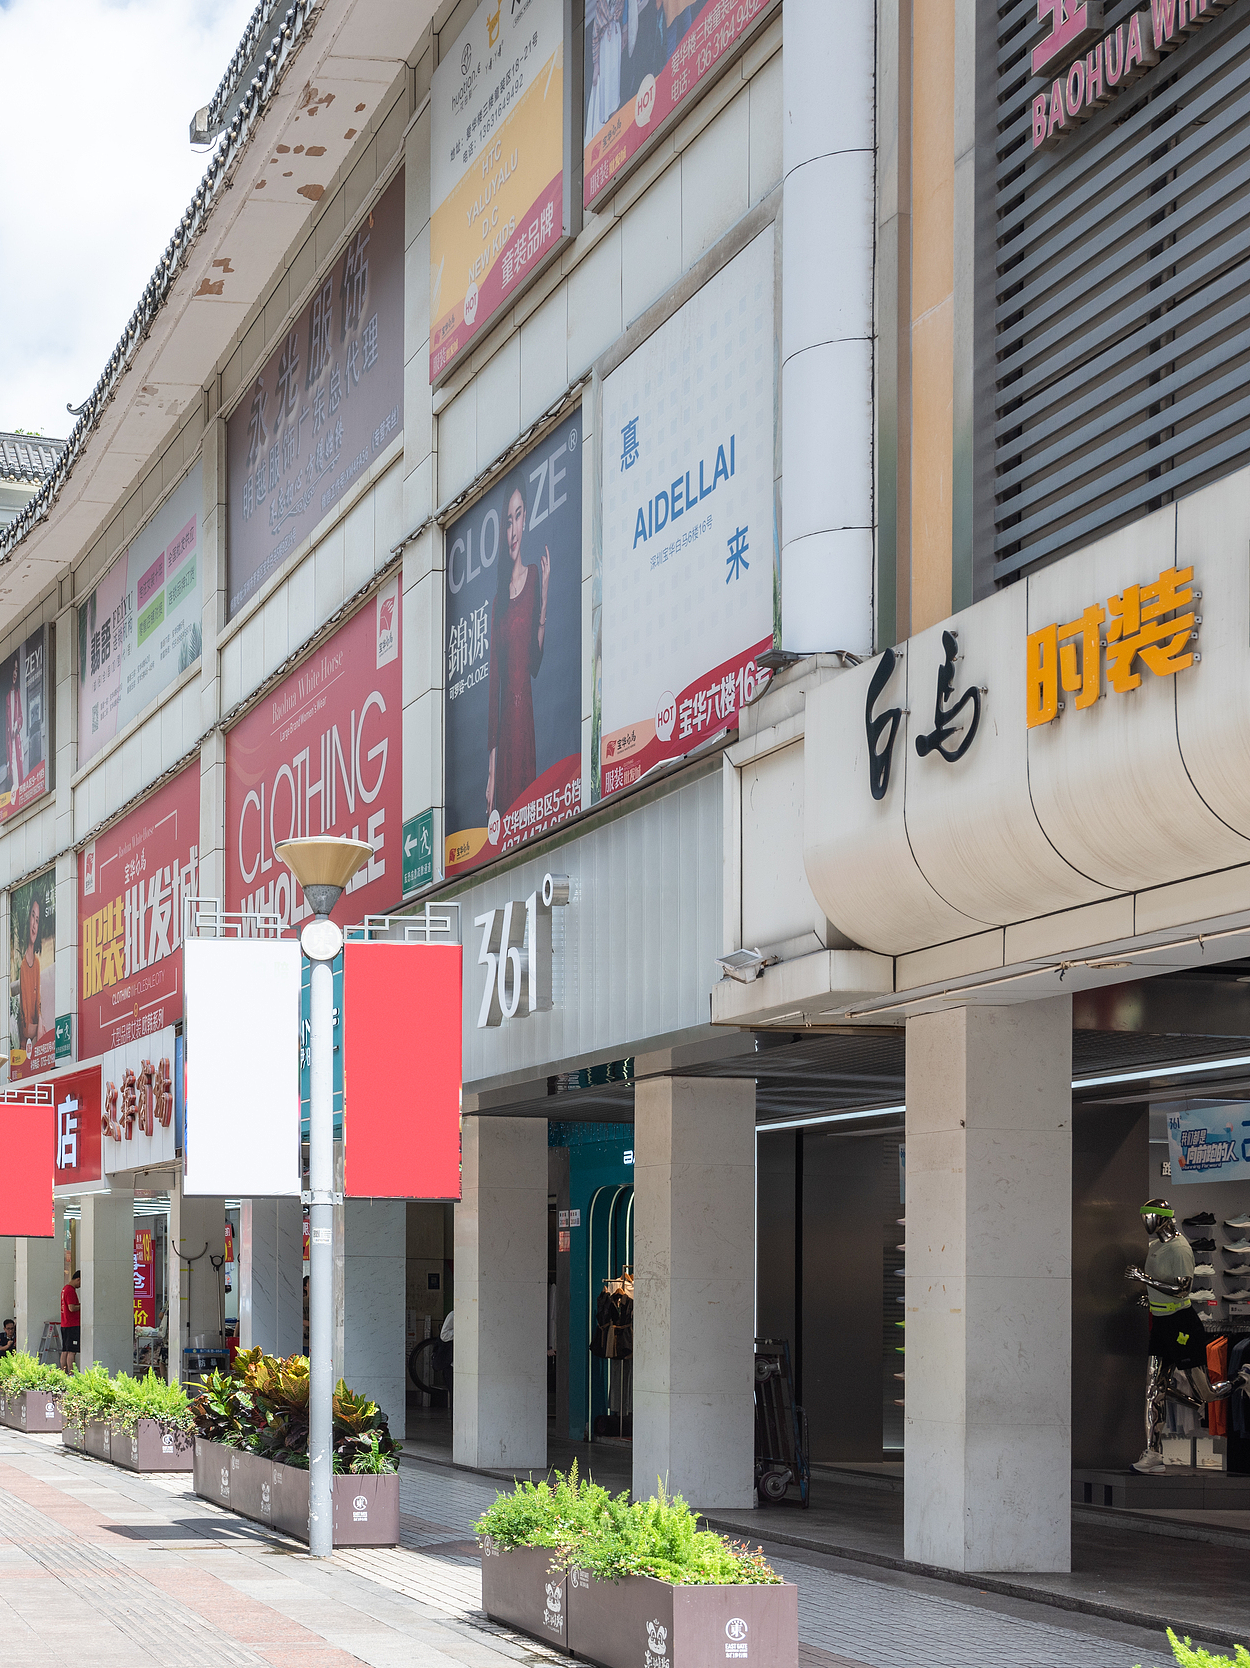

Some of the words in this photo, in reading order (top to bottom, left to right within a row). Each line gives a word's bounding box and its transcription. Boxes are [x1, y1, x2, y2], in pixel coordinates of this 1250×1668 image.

[636, 86, 654, 117] HOT
[1031, 11, 1143, 150] BAOHUA
[466, 148, 519, 228] YALUYALU
[482, 140, 502, 180] HTC
[468, 244, 492, 286] NEW
[491, 214, 517, 257] KIDS
[500, 200, 555, 291] 童装品牌
[465, 291, 479, 317] HOT
[249, 231, 372, 459] 永光服饰
[242, 311, 379, 521] 明越服饰广东总代理
[632, 434, 736, 551] AIDELLAI
[724, 524, 750, 586] 来
[1025, 564, 1195, 731] 时装
[271, 690, 298, 726] Baohua
[298, 666, 321, 700] White
[320, 649, 344, 681] Horse
[657, 705, 675, 729] HOT
[239, 690, 389, 884] CLOTHING
[604, 764, 624, 795] 服装
[474, 872, 554, 1030] 361°
[56, 1093, 80, 1170] 店
[1181, 1130, 1207, 1147] 我们都是
[1186, 1141, 1239, 1165] 向前跑的人
